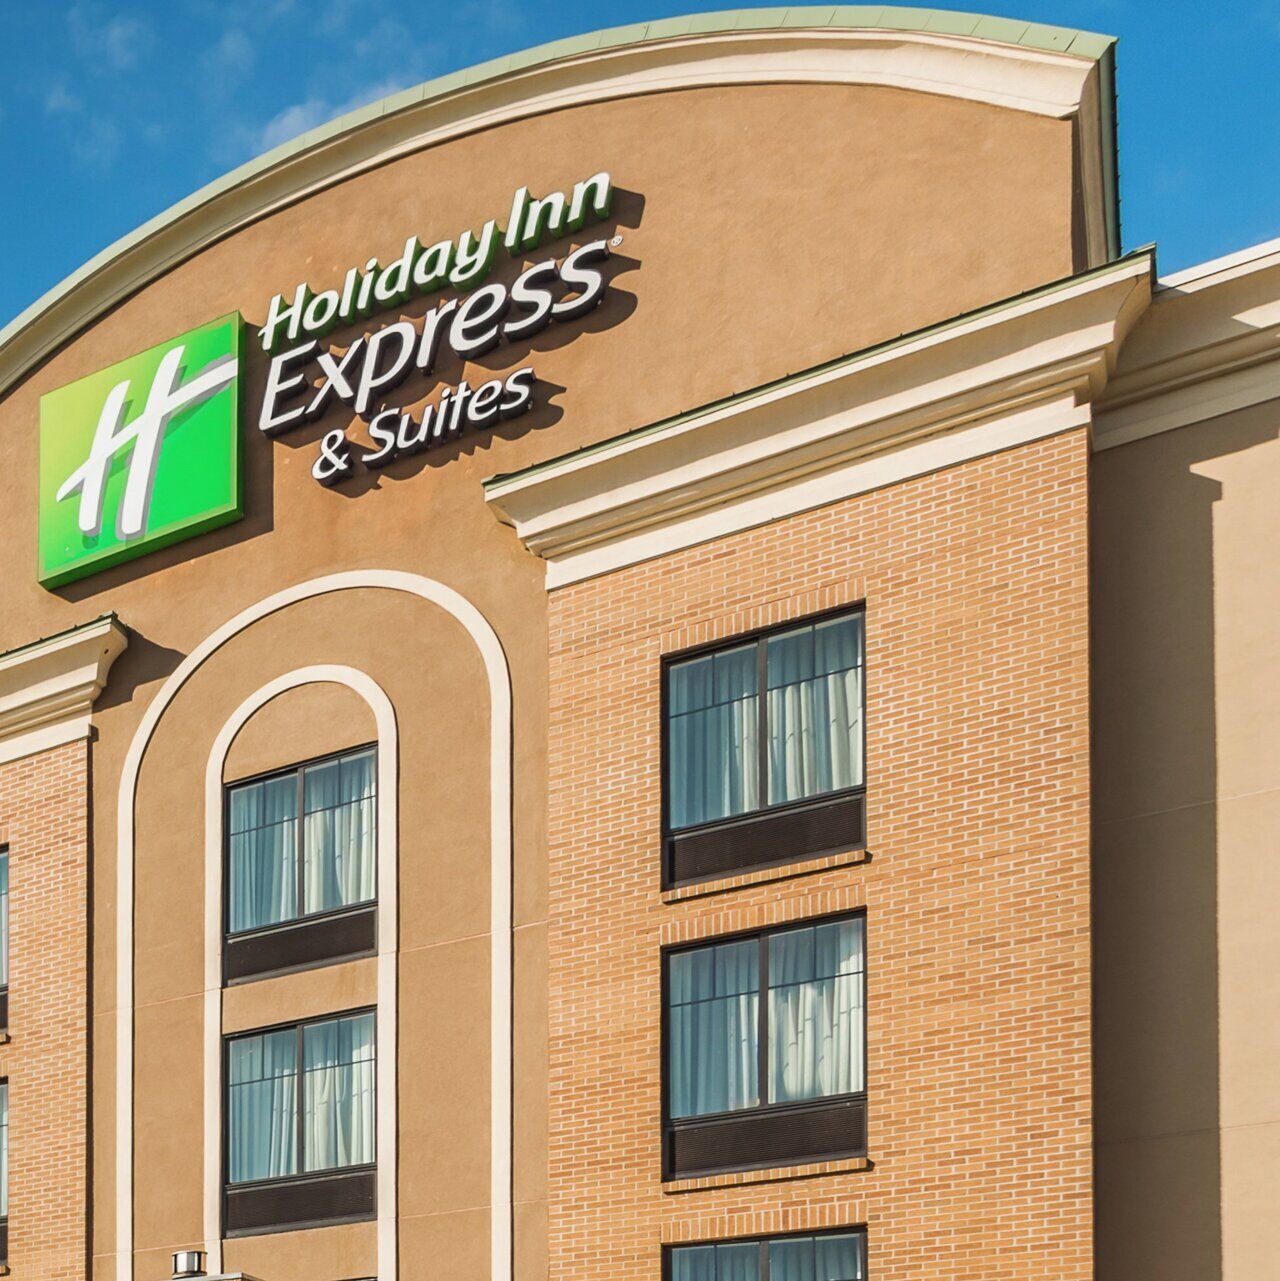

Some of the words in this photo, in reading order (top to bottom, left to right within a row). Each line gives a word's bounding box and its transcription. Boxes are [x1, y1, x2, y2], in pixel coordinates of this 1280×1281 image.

[257, 219, 496, 351] Holiday
[504, 171, 611, 249] Inn
[258, 239, 607, 431] Express
[311, 428, 350, 480] &
[361, 366, 534, 462] Suites
